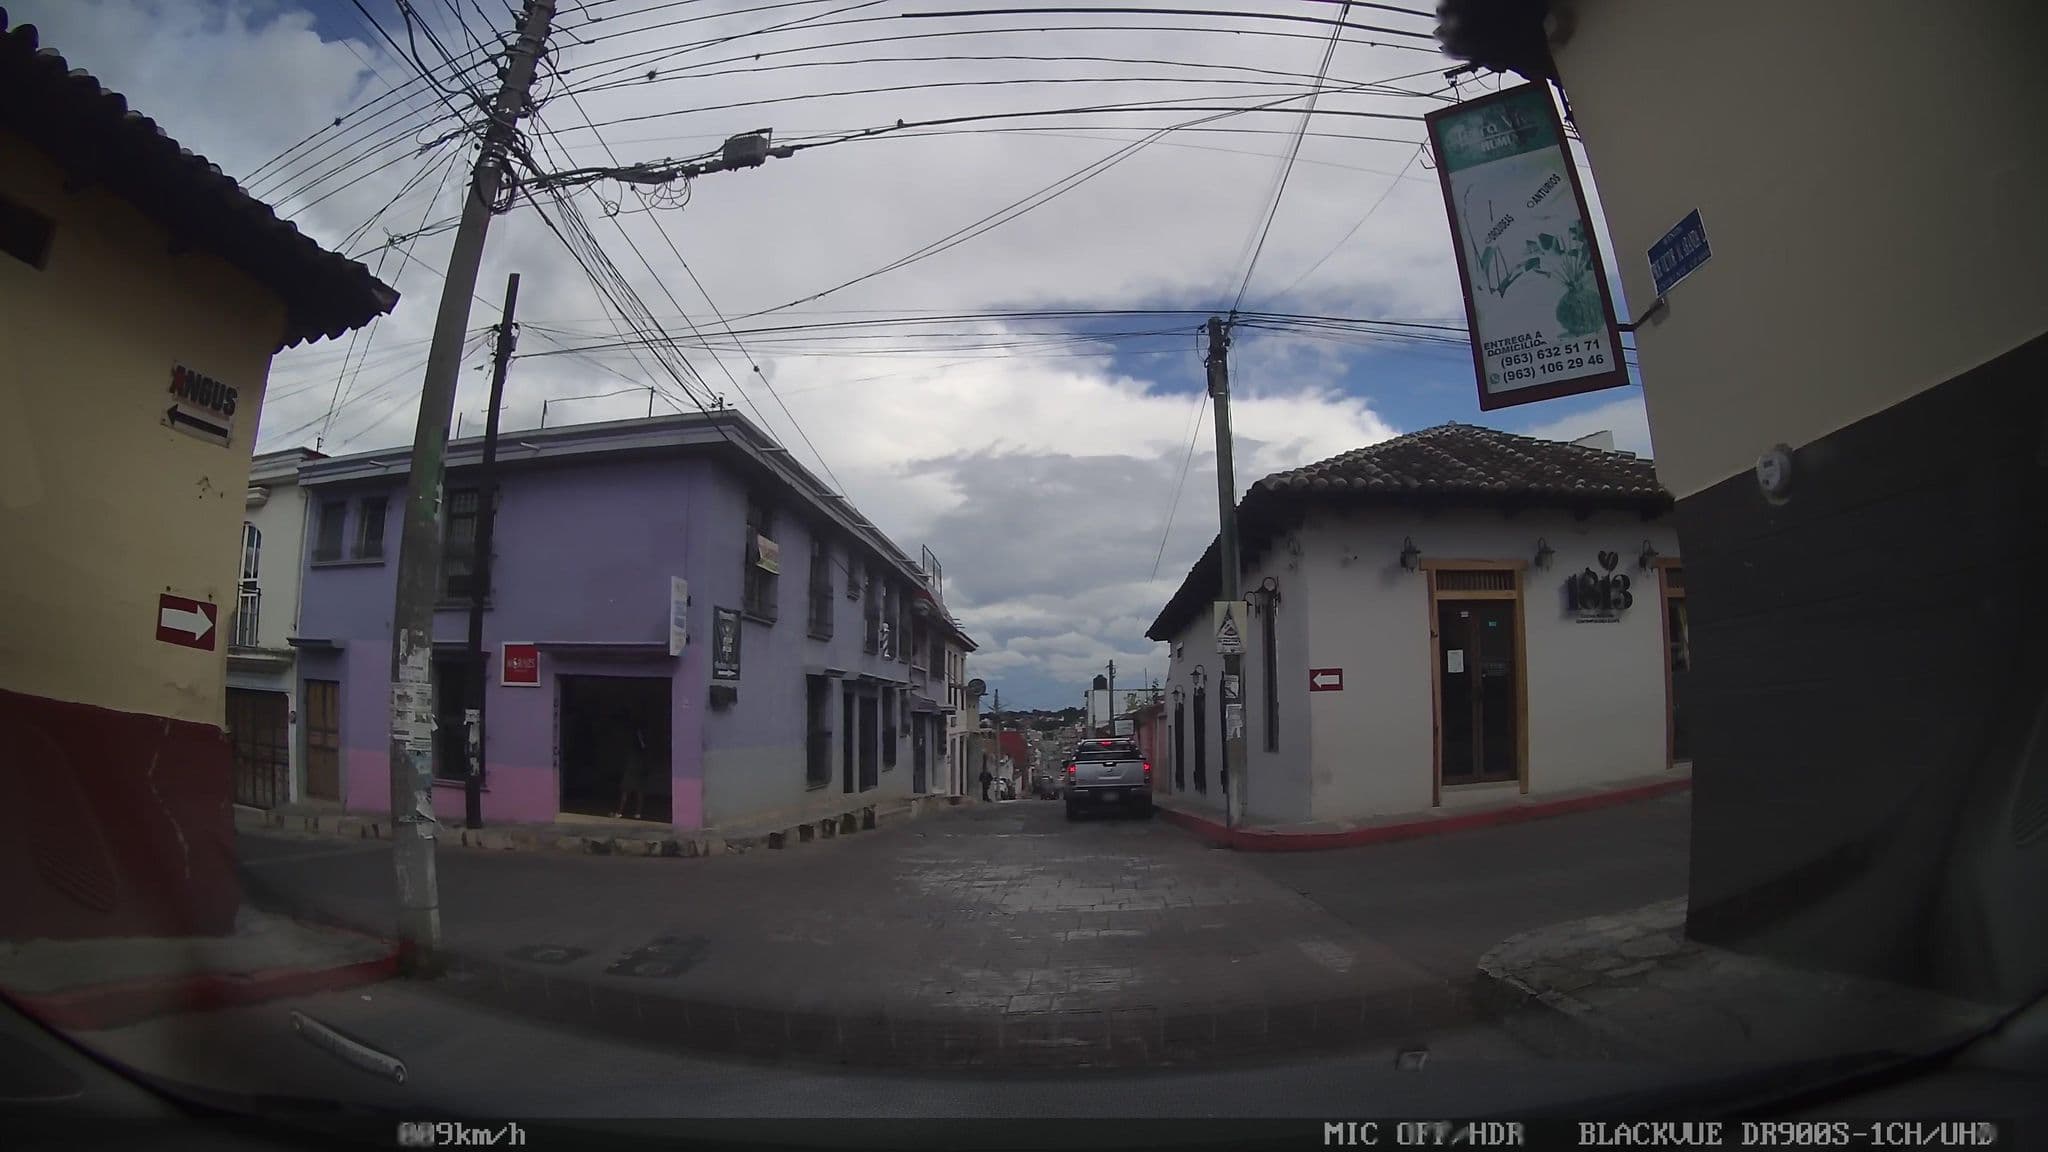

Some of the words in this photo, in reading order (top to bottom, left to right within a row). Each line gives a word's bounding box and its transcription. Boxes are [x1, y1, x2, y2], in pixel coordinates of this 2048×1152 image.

[1484, 332, 1532, 350] ENTREGA
[1535, 331, 1543, 340] A
[1501, 352, 1534, 369] (963)
[1537, 346, 1561, 360] 632
[1564, 344, 1580, 354] 51
[1584, 339, 1600, 351] 71
[1503, 367, 1536, 384] (963)
[1540, 361, 1563, 375] 106
[1567, 357, 1583, 370] 29
[1588, 354, 1605, 366] 46
[169, 364, 238, 417] ANGUS
